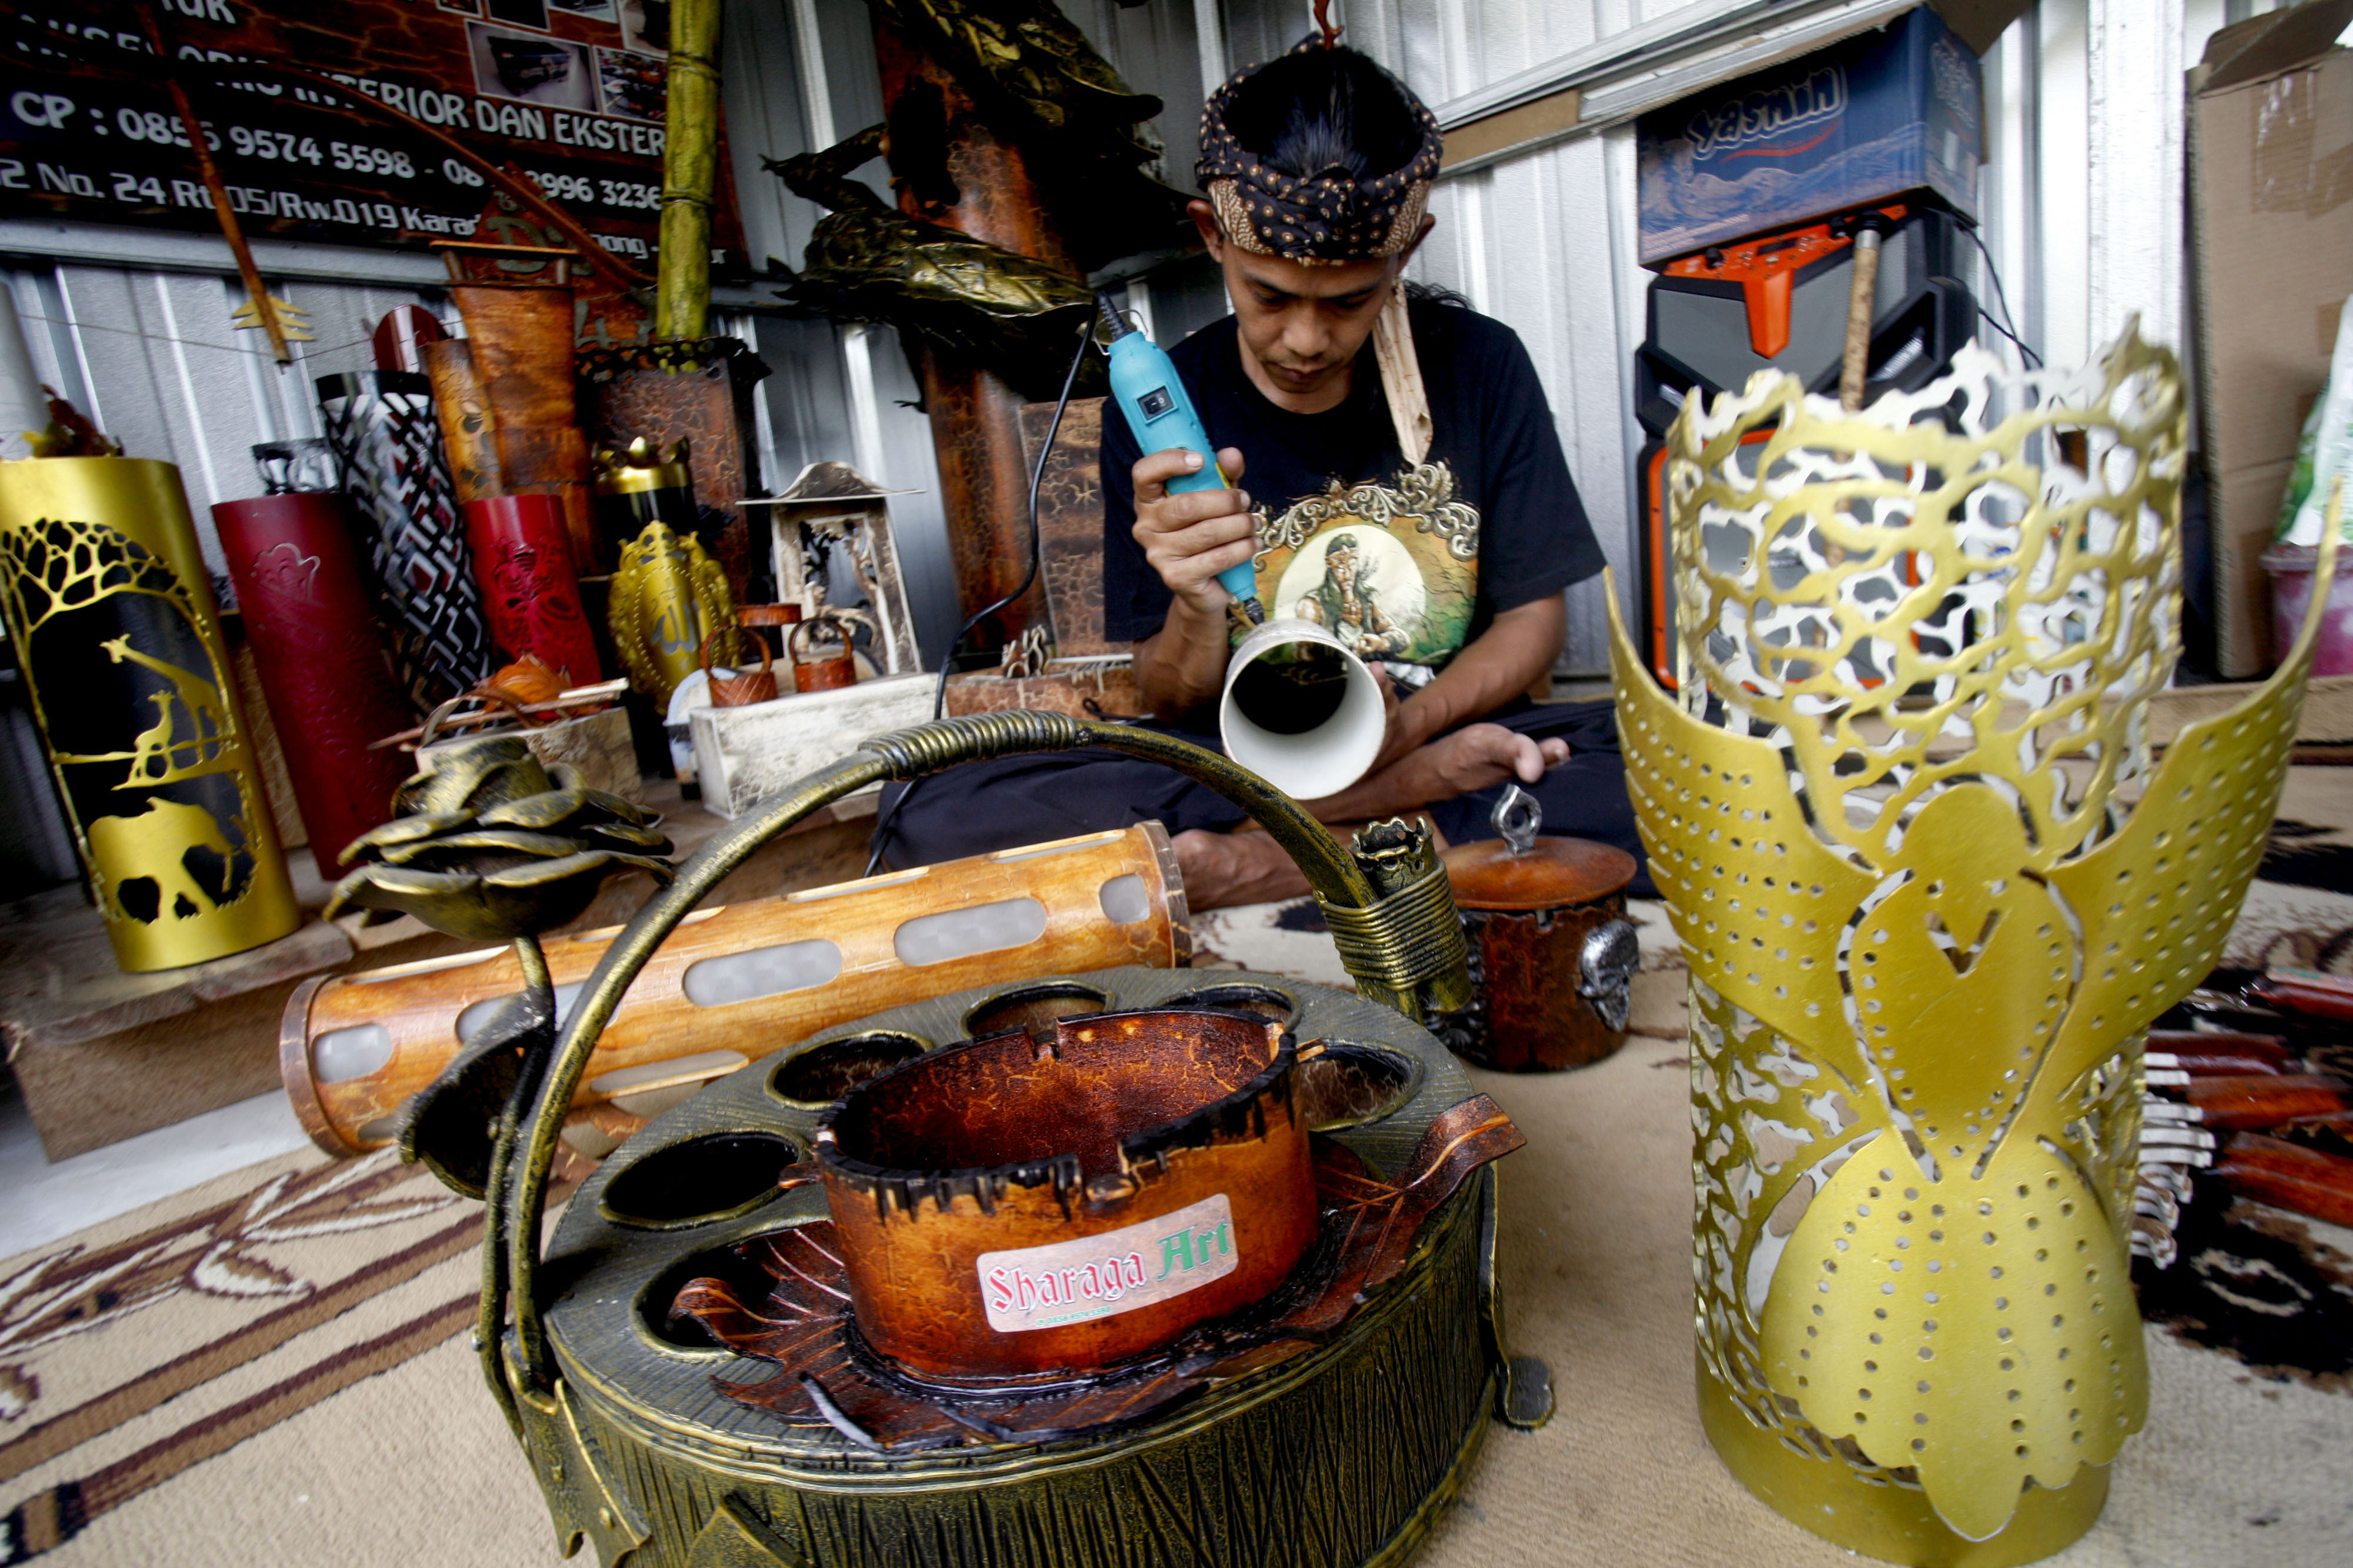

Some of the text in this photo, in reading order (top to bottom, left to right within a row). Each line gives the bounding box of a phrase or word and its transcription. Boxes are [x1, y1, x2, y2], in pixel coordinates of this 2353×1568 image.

[11, 91, 75, 129] CP
[229, 126, 323, 165] 9574
[330, 141, 415, 178] 5598
[474, 99, 546, 140] DAN
[36, 162, 105, 198] No.
[109, 172, 167, 205] 24
[402, 206, 482, 236] Kara
[985, 1219, 1233, 1313] Sharaga Art
